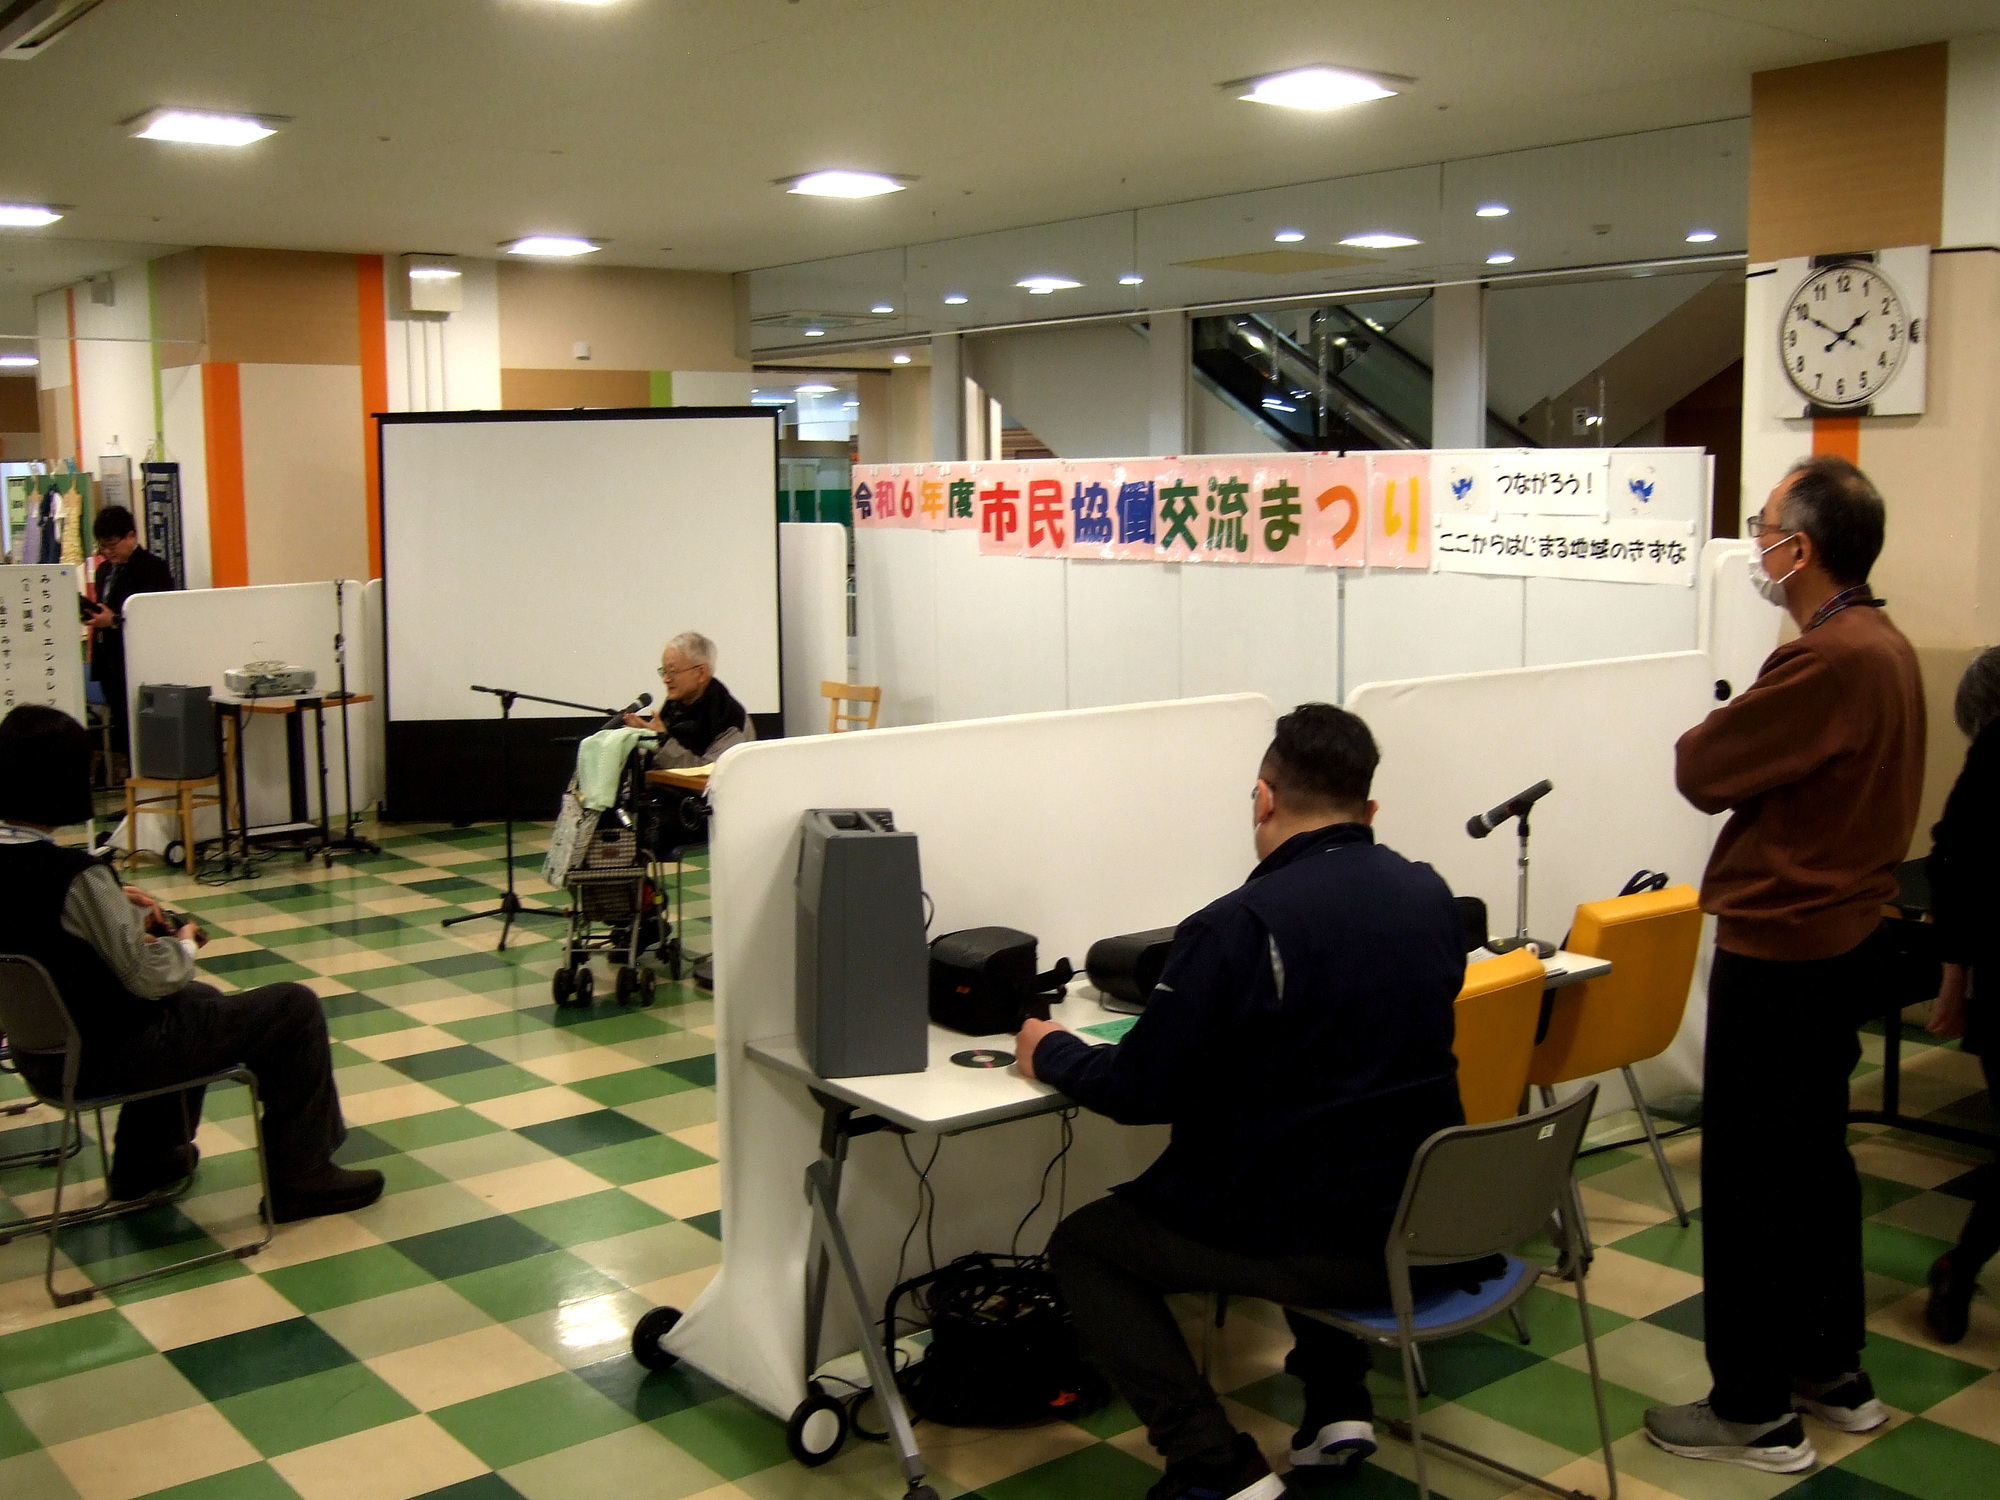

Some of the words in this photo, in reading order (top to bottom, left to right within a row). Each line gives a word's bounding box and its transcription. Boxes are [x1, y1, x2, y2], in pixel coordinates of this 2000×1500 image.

[1813, 283, 1827, 302] 11
[1836, 274, 1851, 293] 12
[1863, 279, 1870, 298] 1
[1795, 303, 1809, 321] 10
[1882, 297, 1891, 316] 2
[1788, 329, 1798, 348] 9
[1888, 323, 1898, 341] 3
[1796, 355, 1805, 373] 8
[1877, 351, 1887, 369] 4
[1815, 373, 1824, 390] 7
[1836, 378, 1845, 396] 6
[1859, 370, 1868, 389] 5
[1439, 533, 1687, 565] ここからはじまる地域のきずな
